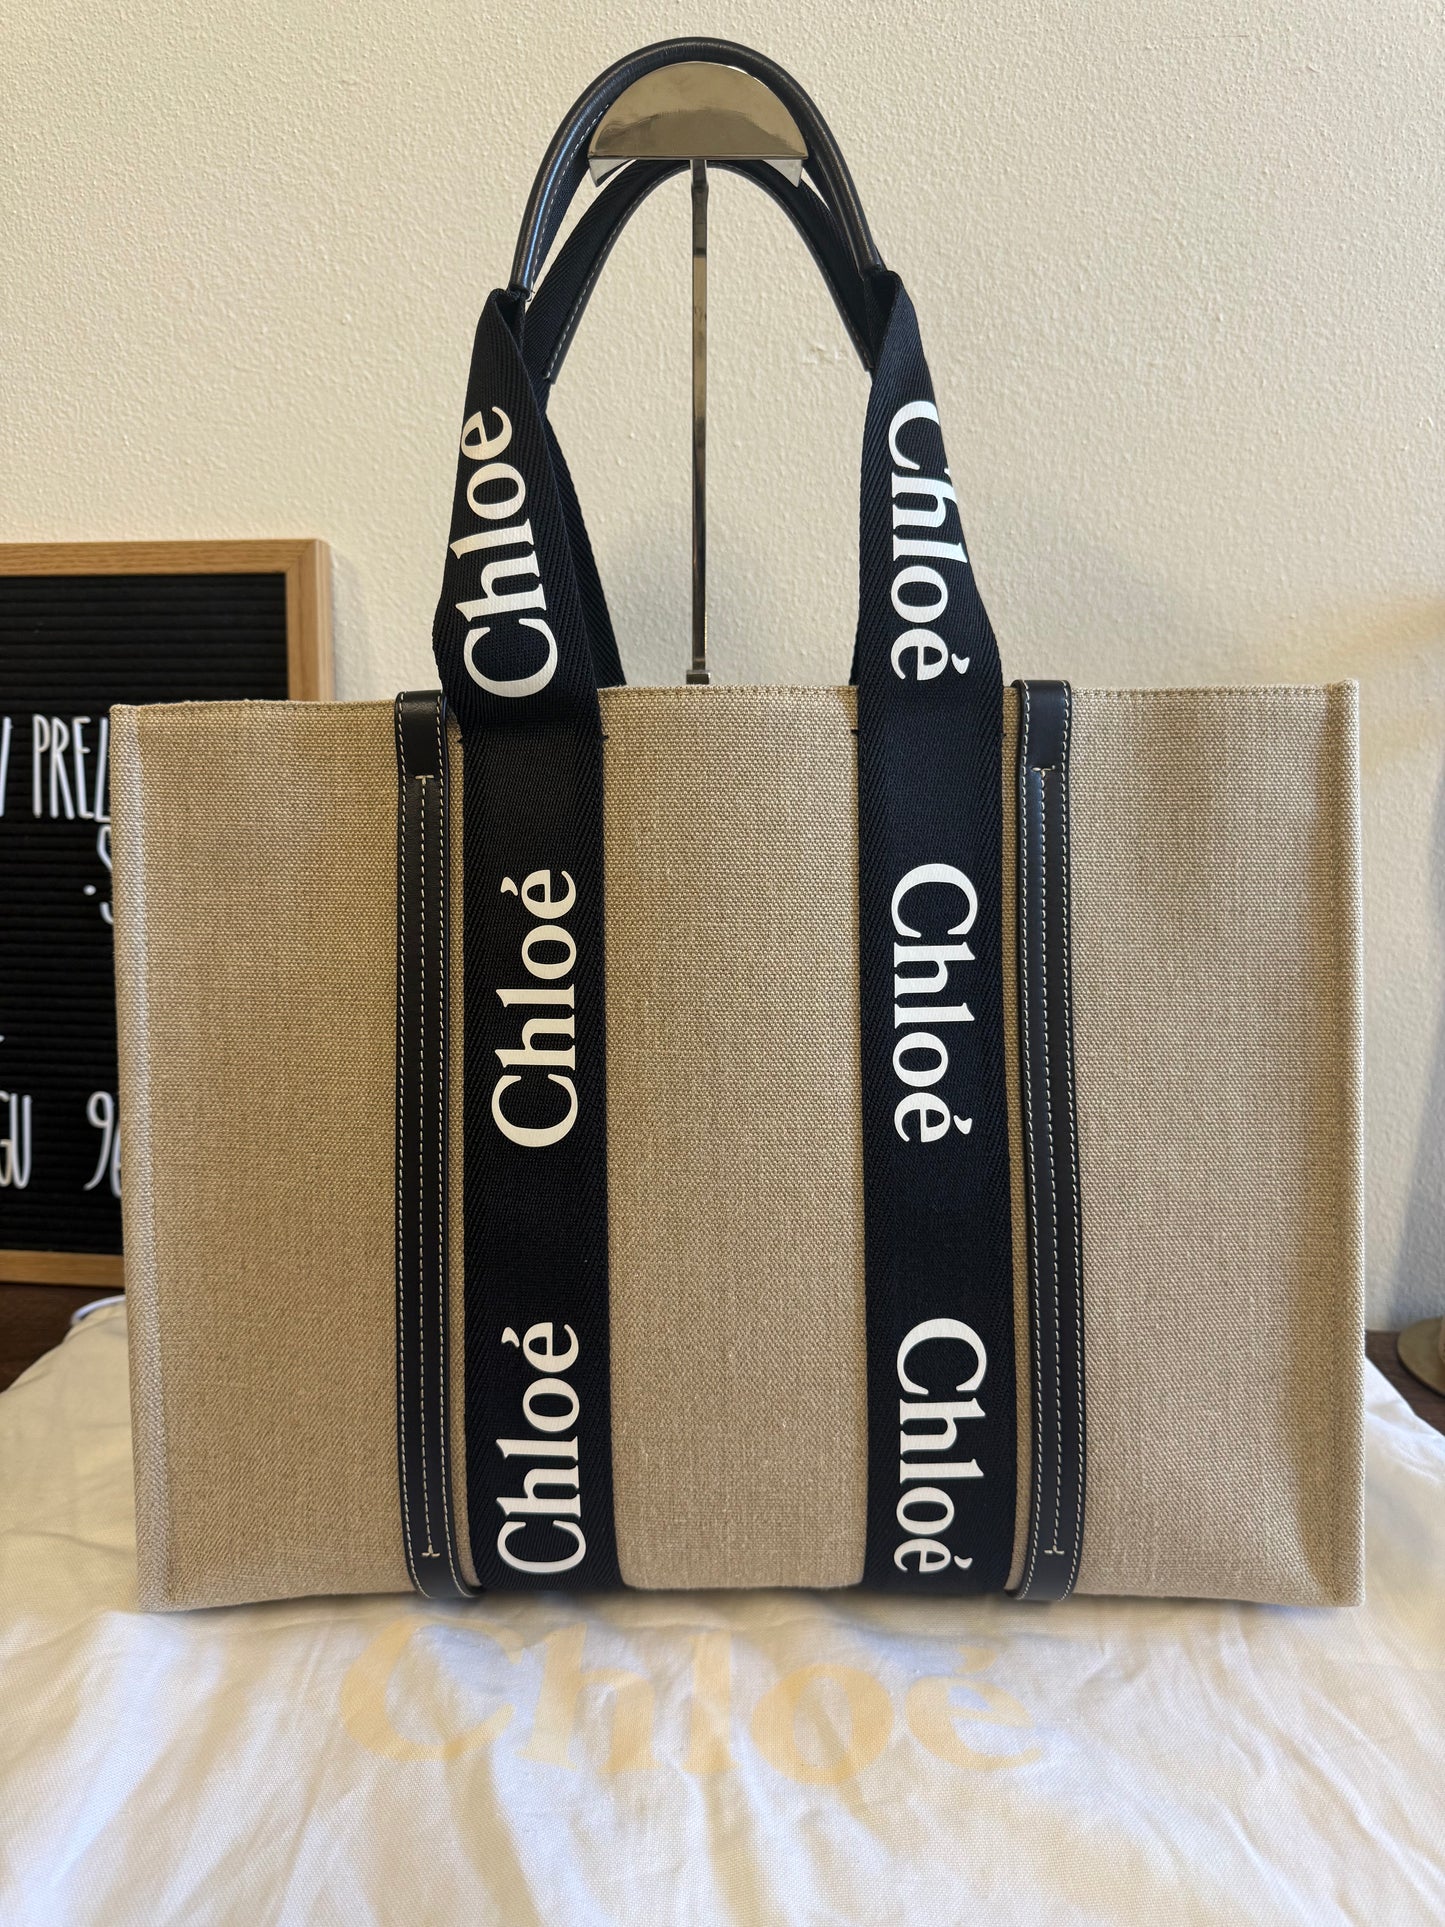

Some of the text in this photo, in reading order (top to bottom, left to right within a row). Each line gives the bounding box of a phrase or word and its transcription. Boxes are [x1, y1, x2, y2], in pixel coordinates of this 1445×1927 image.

[491, 869, 578, 1148] Chloé
[891, 863, 978, 1143] Chloé
[496, 1321, 587, 1574] Chloé
[893, 1317, 987, 1575] Chloé
